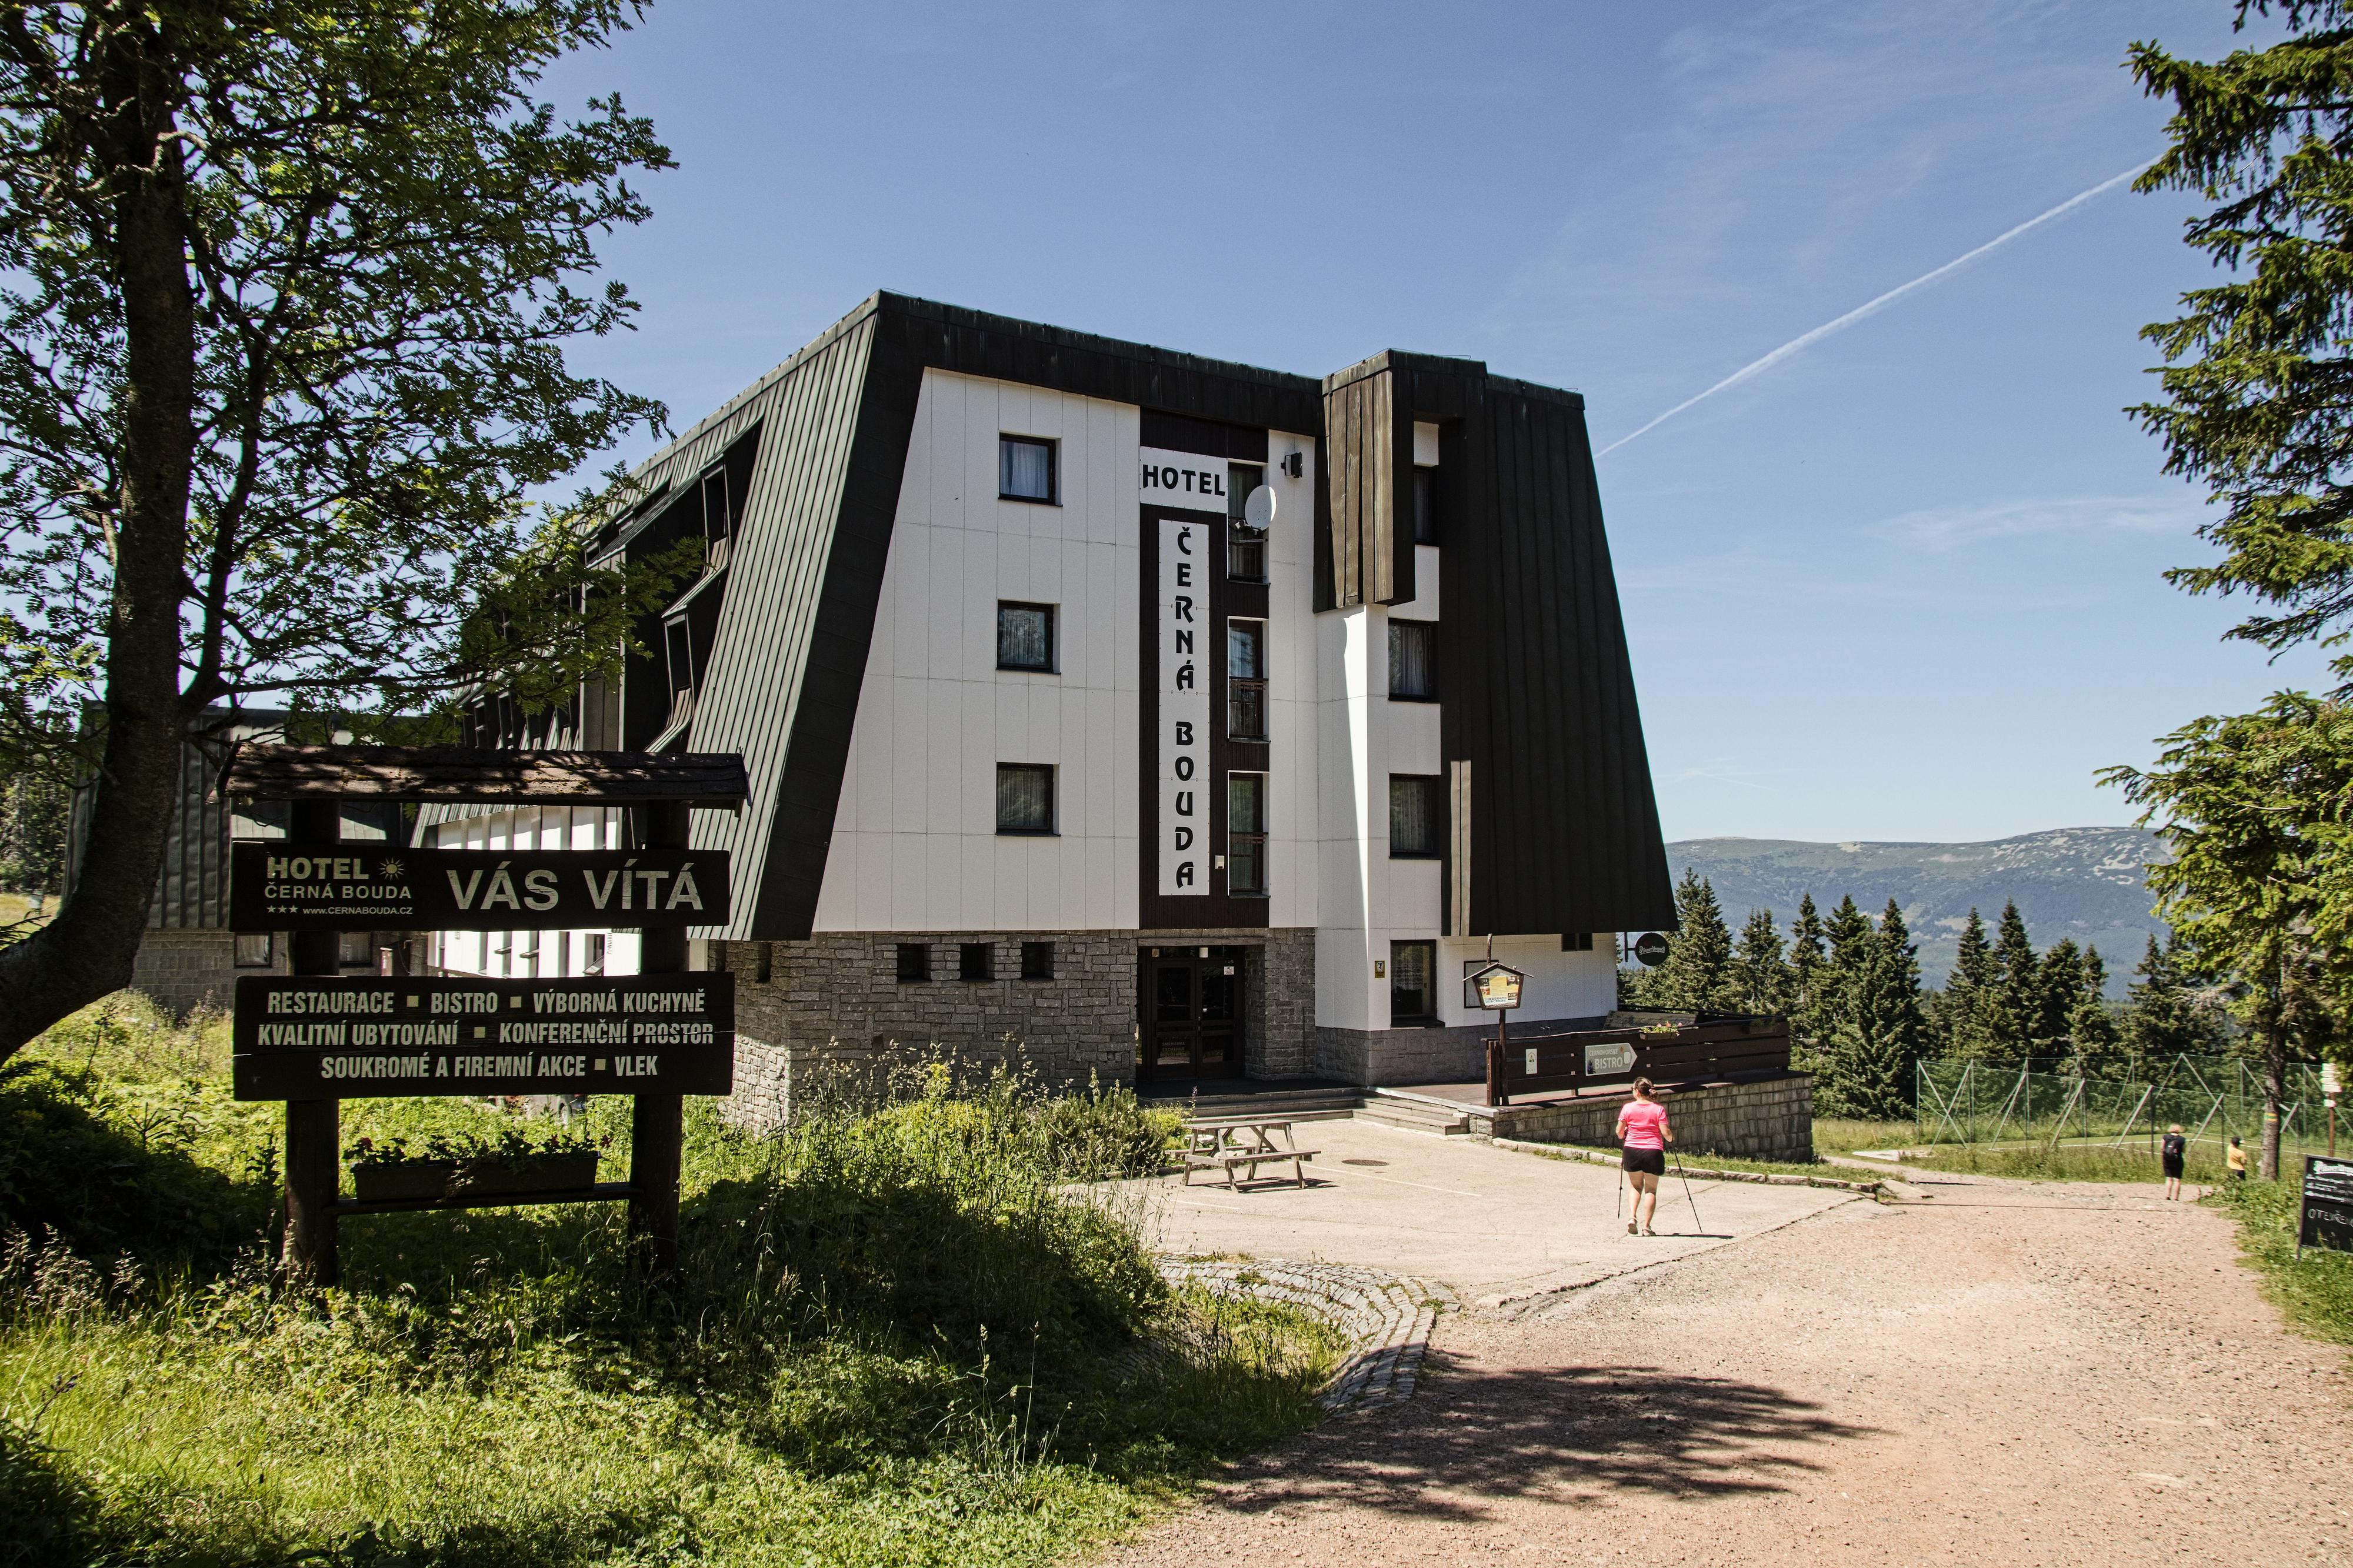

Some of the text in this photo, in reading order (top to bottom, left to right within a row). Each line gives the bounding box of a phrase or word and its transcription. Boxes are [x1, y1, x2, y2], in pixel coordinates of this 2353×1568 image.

[1142, 463, 1226, 496] HOTEL
[1175, 526, 1195, 889] ČERNÁ BOUDA
[267, 857, 369, 880] HOTEL
[265, 882, 412, 899] ČERNÁ BOUDA
[445, 858, 704, 911] VÁS VÍTÁ
[302, 906, 413, 915] www.CERNABOUDA.CZ
[268, 988, 706, 1013] RESTAURACE BISTRO VÝBORNÁ KUCHYNĚ
[258, 1019, 714, 1046] KVALITNÍ UBYTOVÁNÍ KONFERENČNÍ PROSTOR
[321, 1052, 659, 1078] SOUKROMÉ A FIREMNÍ AKCE VLEK
[1595, 1056, 1624, 1070] BISTRO
